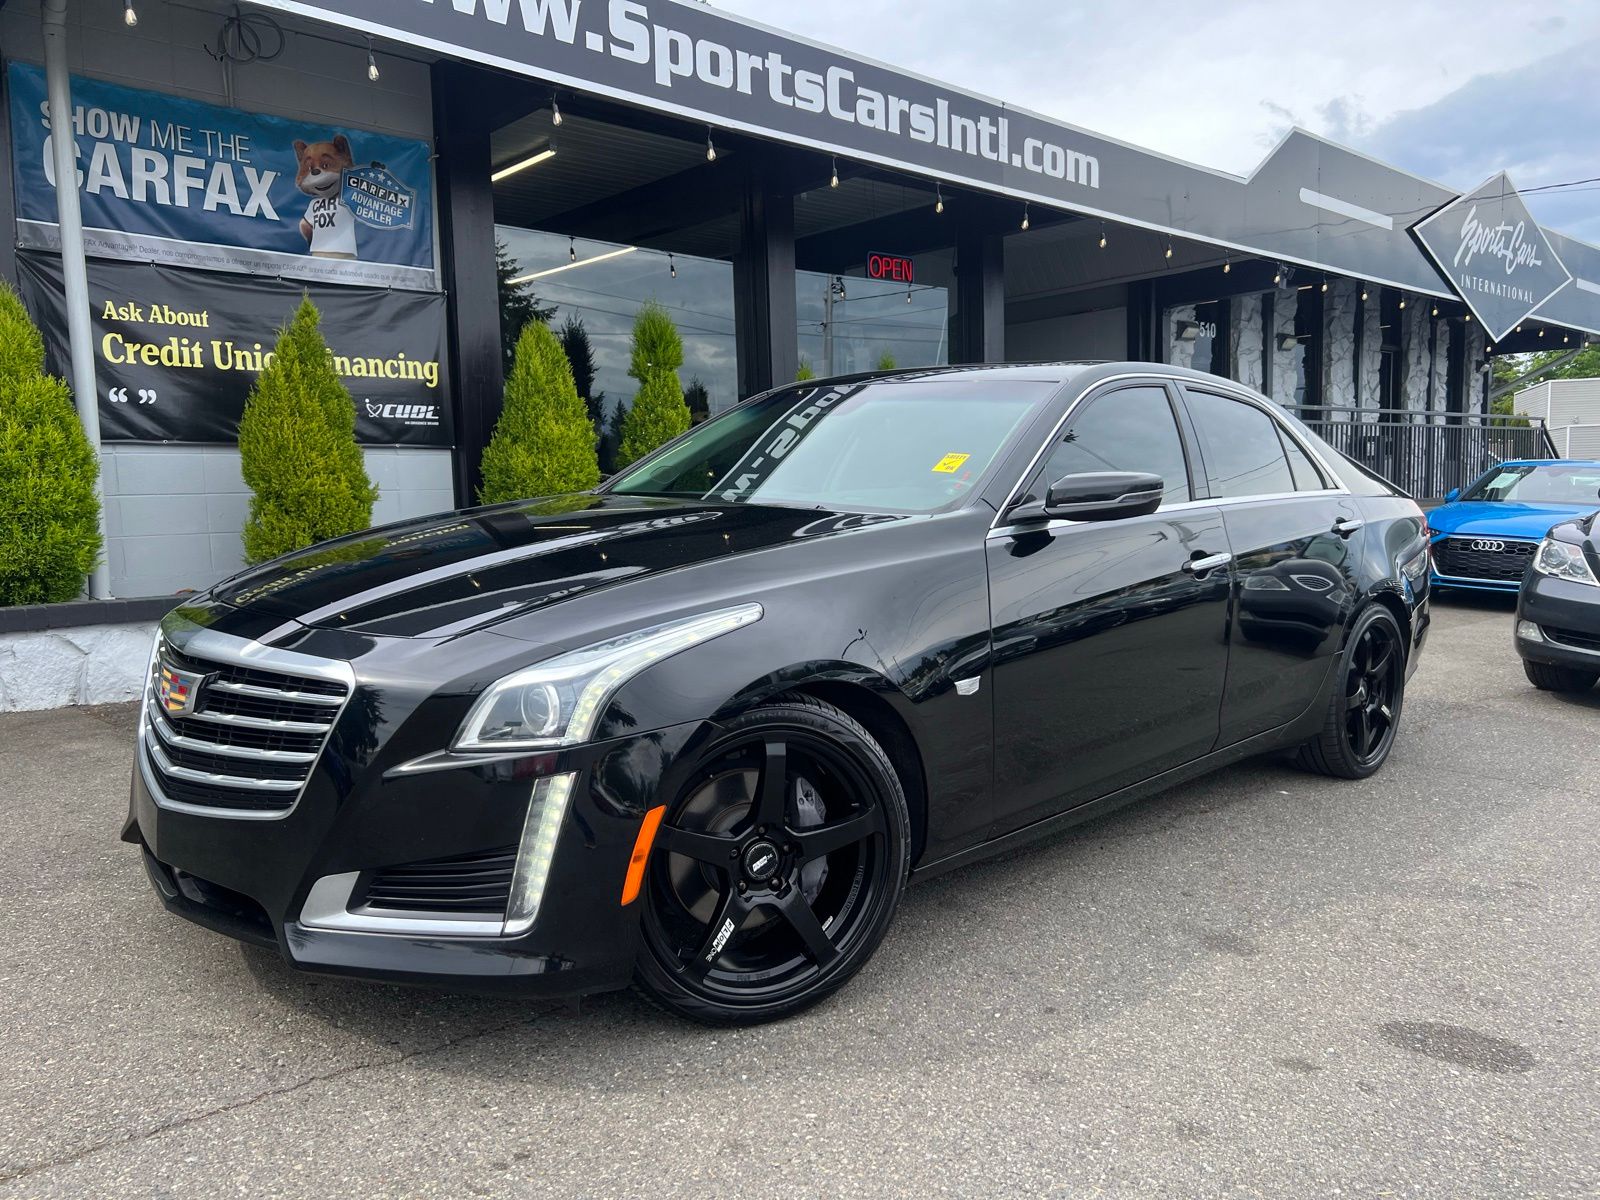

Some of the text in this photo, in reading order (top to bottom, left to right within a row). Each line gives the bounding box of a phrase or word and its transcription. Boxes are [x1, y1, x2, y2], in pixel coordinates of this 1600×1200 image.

[151, 119, 193, 153] ME
[199, 129, 250, 163] THE
[313, 197, 337, 213] CAR
[348, 176, 409, 207] CARFAX
[351, 192, 403, 218] ADVANTAGE
[313, 212, 336, 229] FOX
[356, 206, 392, 226] DEALER
[1454, 204, 1542, 275] Sports Cars
[870, 255, 912, 282] OPEN
[1461, 274, 1534, 304] INTERNATIONAL
[102, 300, 209, 328] Ask About
[1196, 321, 1216, 338] 510
[102, 332, 439, 388] Credit Uni nancing
